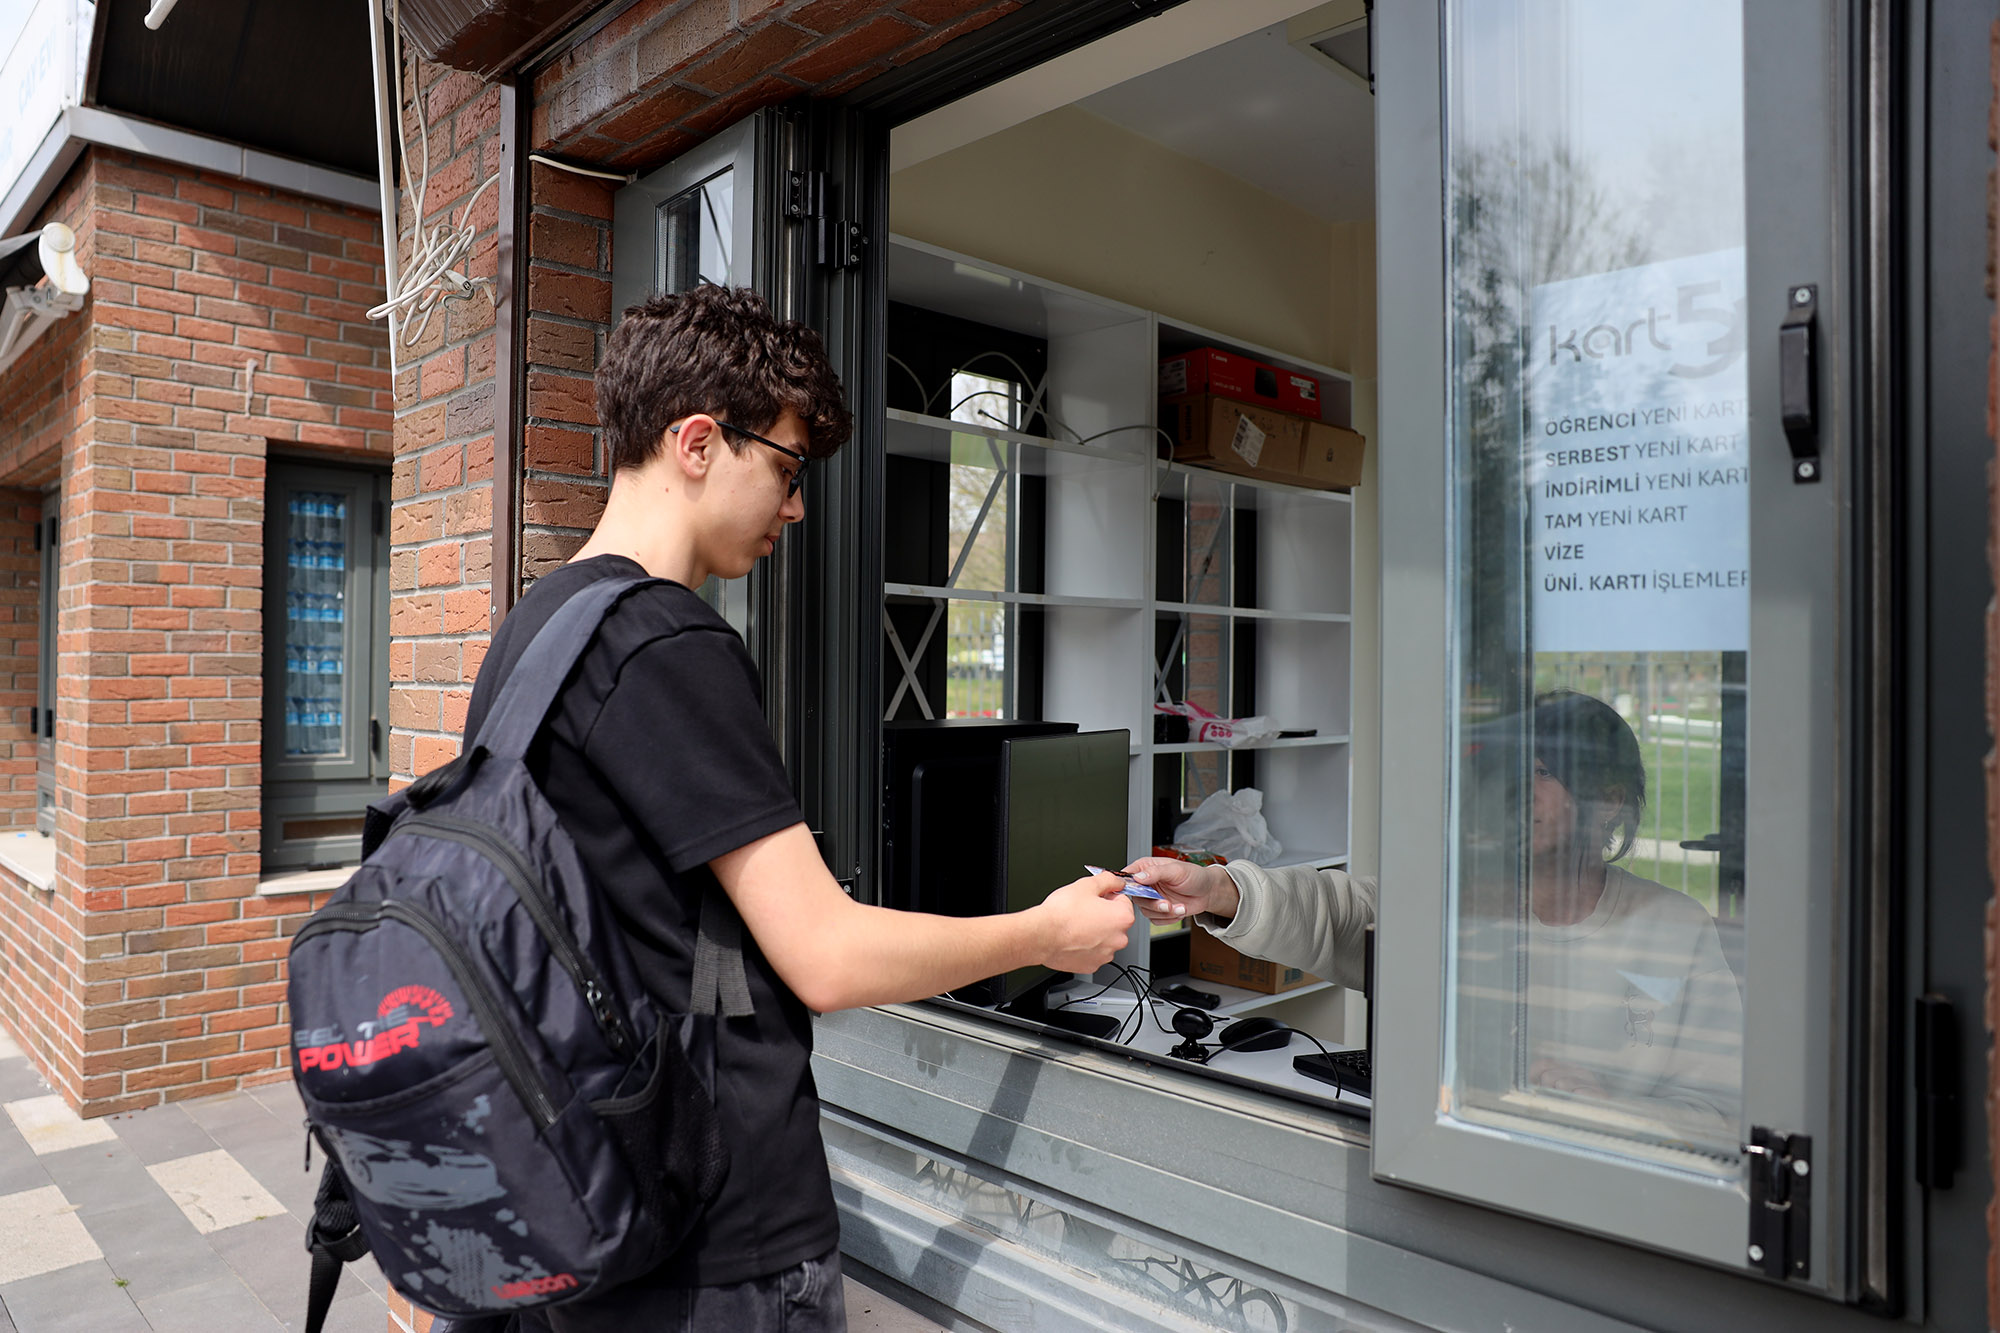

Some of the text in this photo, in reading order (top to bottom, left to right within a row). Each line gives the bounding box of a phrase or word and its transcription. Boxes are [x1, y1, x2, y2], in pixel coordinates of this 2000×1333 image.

[1545, 398, 1746, 437] ÖĞRENCİ YENİ KART
[1545, 433, 1740, 467] SERBEST YENİ KART
[1545, 466, 1748, 498] İNDİRİMLİ YENİ KART
[1544, 505, 1689, 530] TAM YENİ KART
[1544, 543, 1585, 561] VİZE
[1544, 572, 1584, 592] ÜNİ.
[1590, 573, 1647, 591] KARTI
[299, 1019, 420, 1074] POWER
